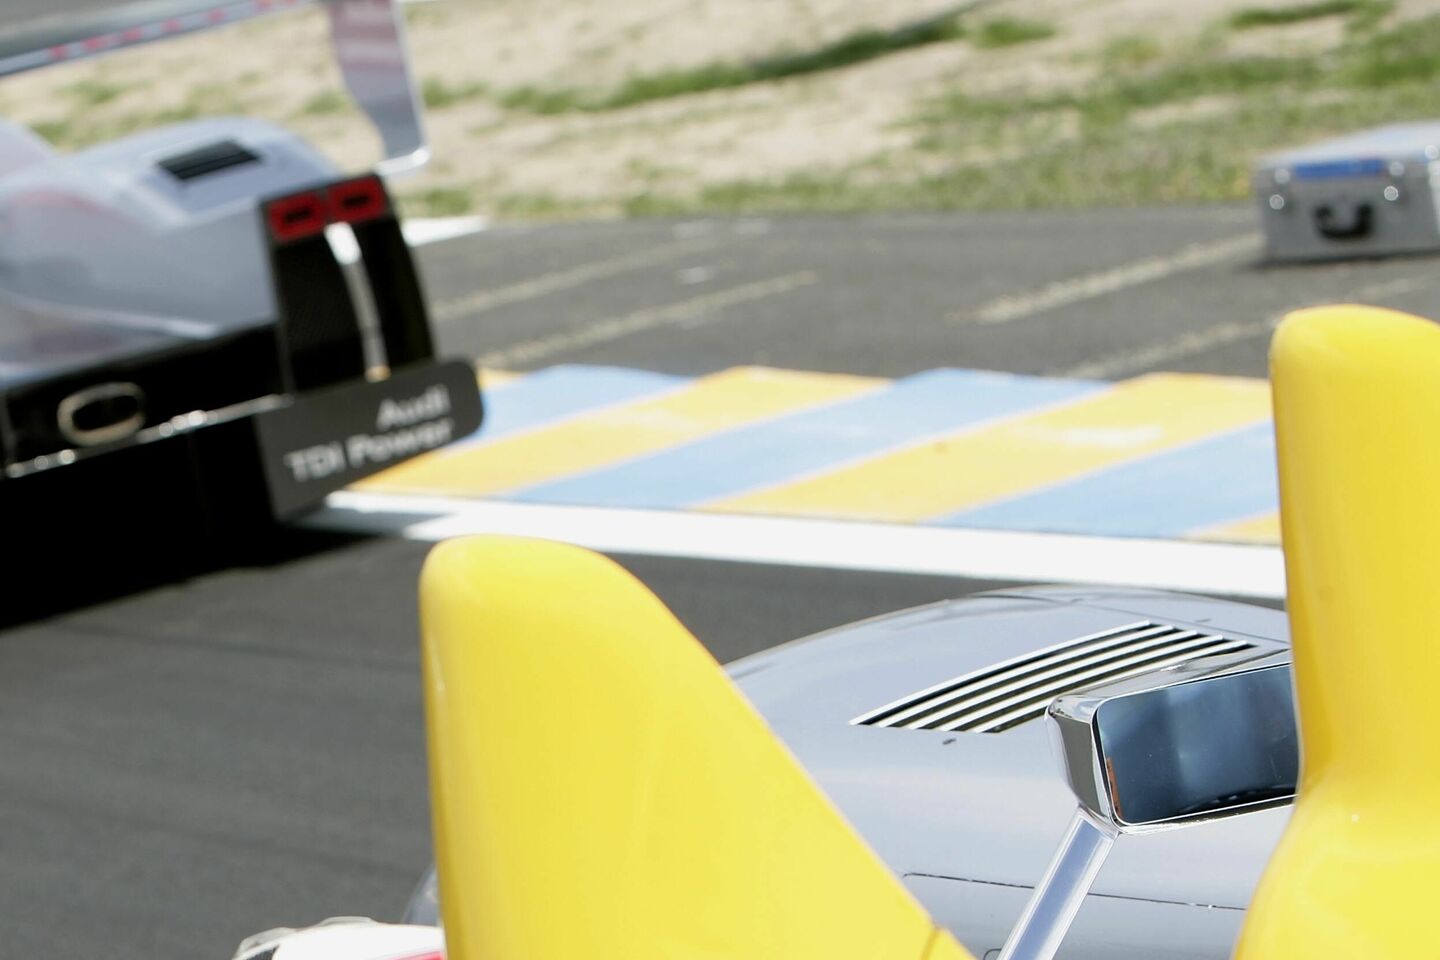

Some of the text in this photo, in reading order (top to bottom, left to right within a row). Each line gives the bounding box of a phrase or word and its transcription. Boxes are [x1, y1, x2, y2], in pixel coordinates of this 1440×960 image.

[376, 384, 451, 431] Audi
[283, 417, 455, 482] TDI Power
